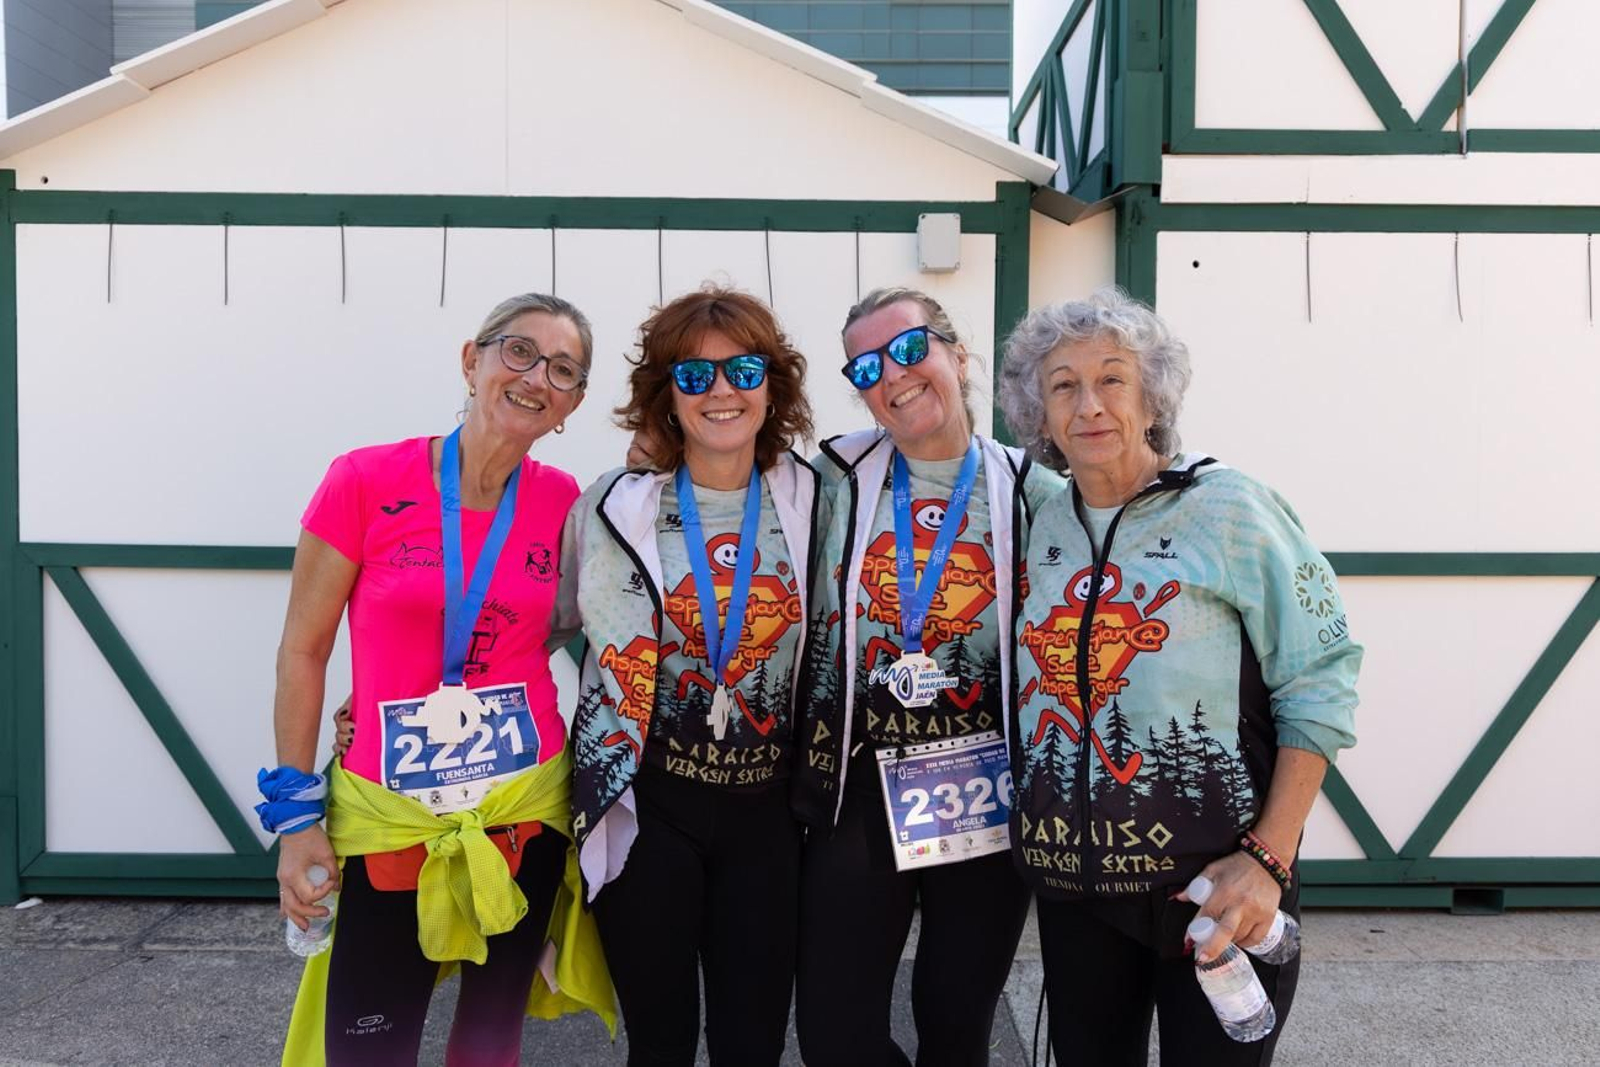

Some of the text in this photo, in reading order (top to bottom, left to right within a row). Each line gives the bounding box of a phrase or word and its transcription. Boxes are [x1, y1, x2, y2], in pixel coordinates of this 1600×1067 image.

[919, 671, 945, 680] MEDIA
[866, 708, 993, 735] PARAISO
[394, 716, 524, 774] 2221
[436, 763, 495, 781] FUENSANTA
[666, 755, 731, 784] VIRGEN
[901, 770, 1014, 827] 2326
[953, 816, 987, 829] ANGELA
[1022, 846, 1175, 874] VIRGEN EXTRA
[1093, 881, 1152, 893] OURMET
